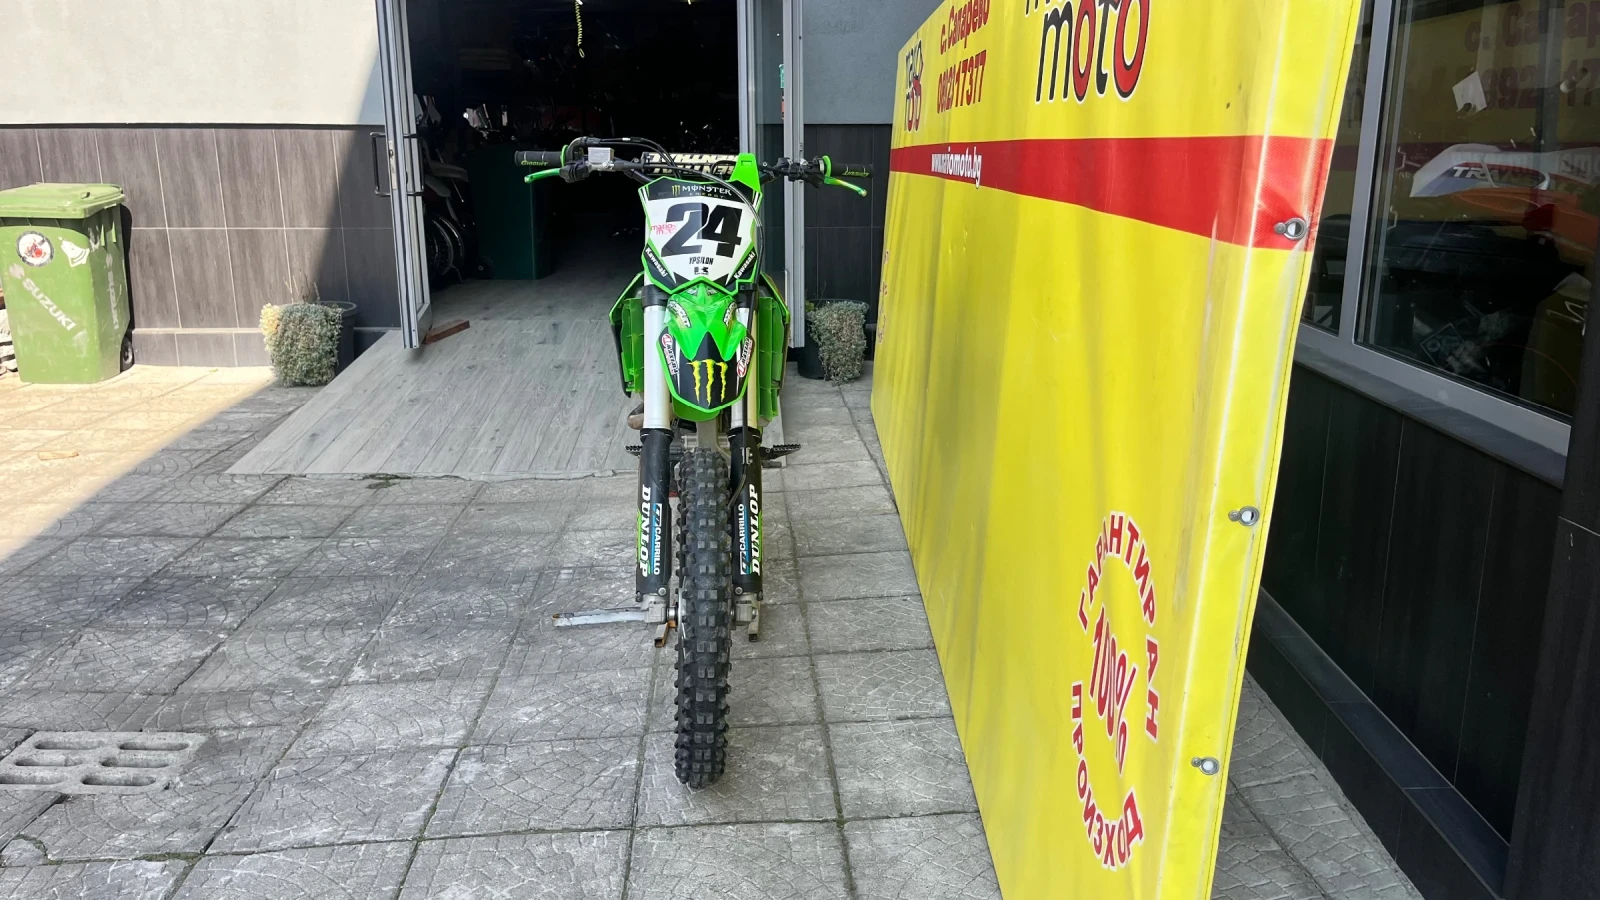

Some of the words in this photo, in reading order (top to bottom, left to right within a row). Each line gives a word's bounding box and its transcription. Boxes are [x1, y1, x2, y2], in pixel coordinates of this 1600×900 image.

[682, 184, 732, 196] MONSTER
[660, 202, 743, 259] 24
[645, 247, 669, 278] Kawasaki
[689, 256, 714, 266] YPSILON
[733, 251, 756, 279] Kawasaki
[22, 278, 76, 331] SUZUKI
[639, 484, 651, 577] DUNLOP
[653, 528, 662, 575] CARRILLO
[737, 503, 746, 551] CARRILLO
[749, 484, 761, 577] DUNLOP
[1089, 606, 1137, 775] 100%
[1071, 683, 1143, 867] ПРОИЗХОД
